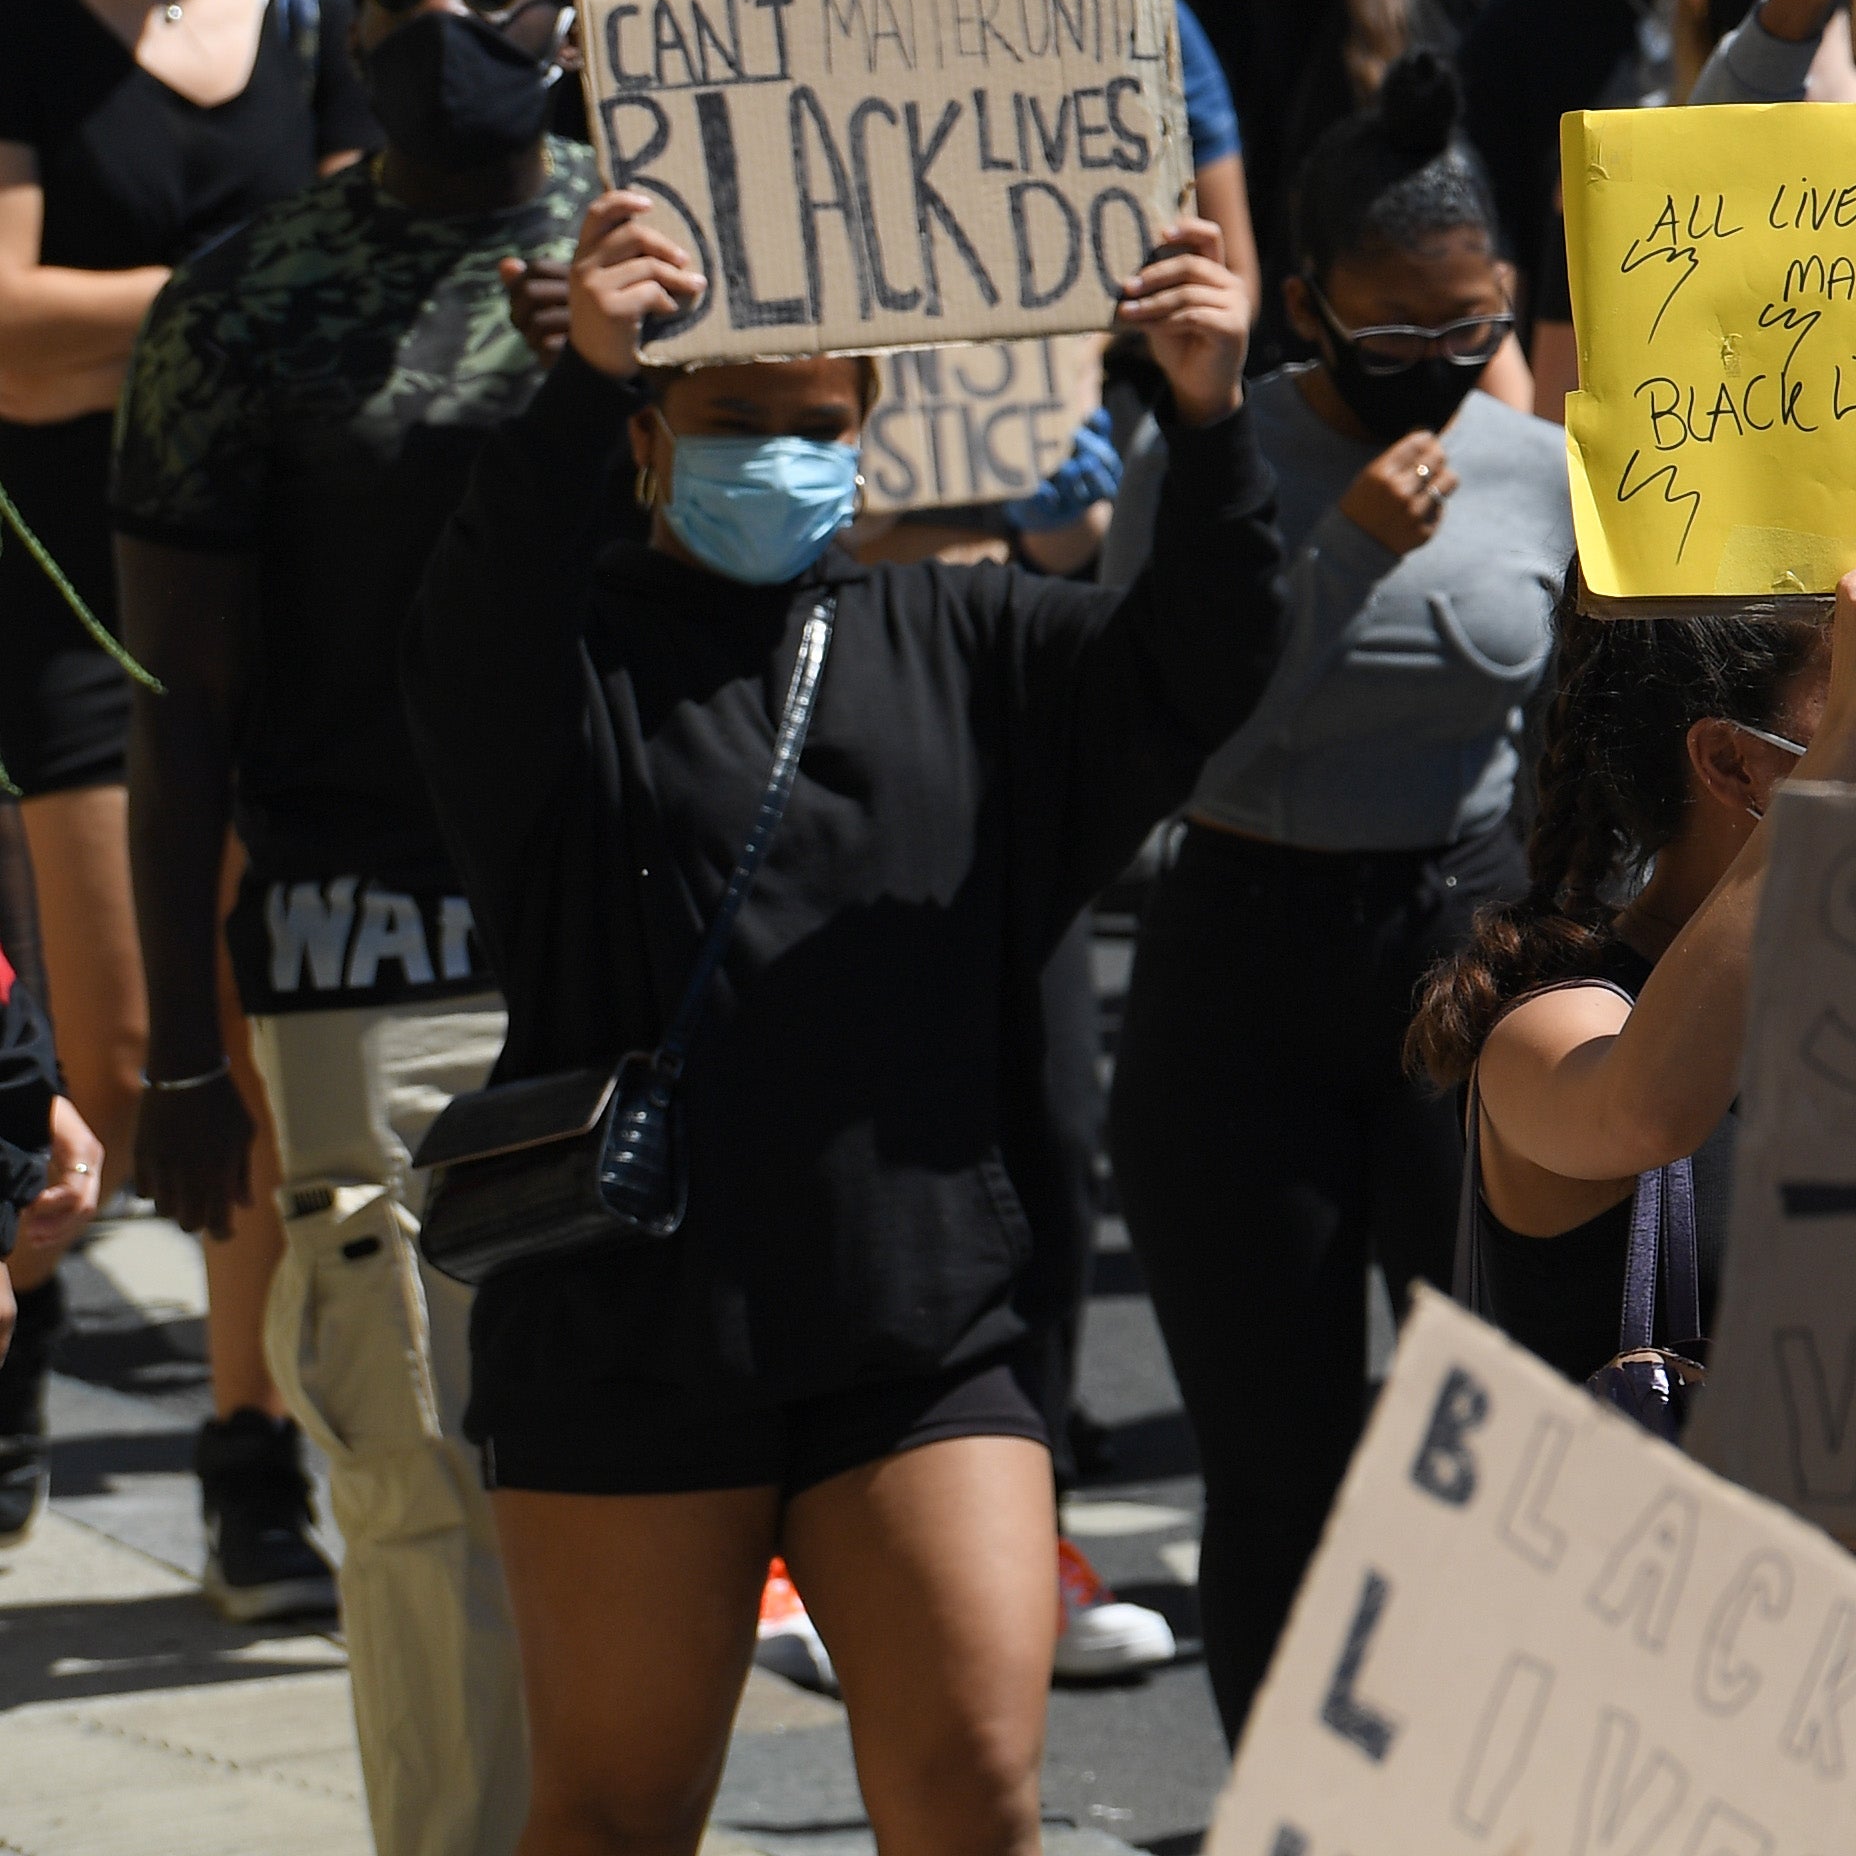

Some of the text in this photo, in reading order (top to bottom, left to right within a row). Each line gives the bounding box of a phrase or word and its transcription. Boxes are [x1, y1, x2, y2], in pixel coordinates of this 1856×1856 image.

[600, 76, 1152, 343] BLACK LIVES
[1009, 178, 1152, 312] DO
[1645, 192, 1744, 246] ALL
[1634, 369, 1820, 453] BLACK
